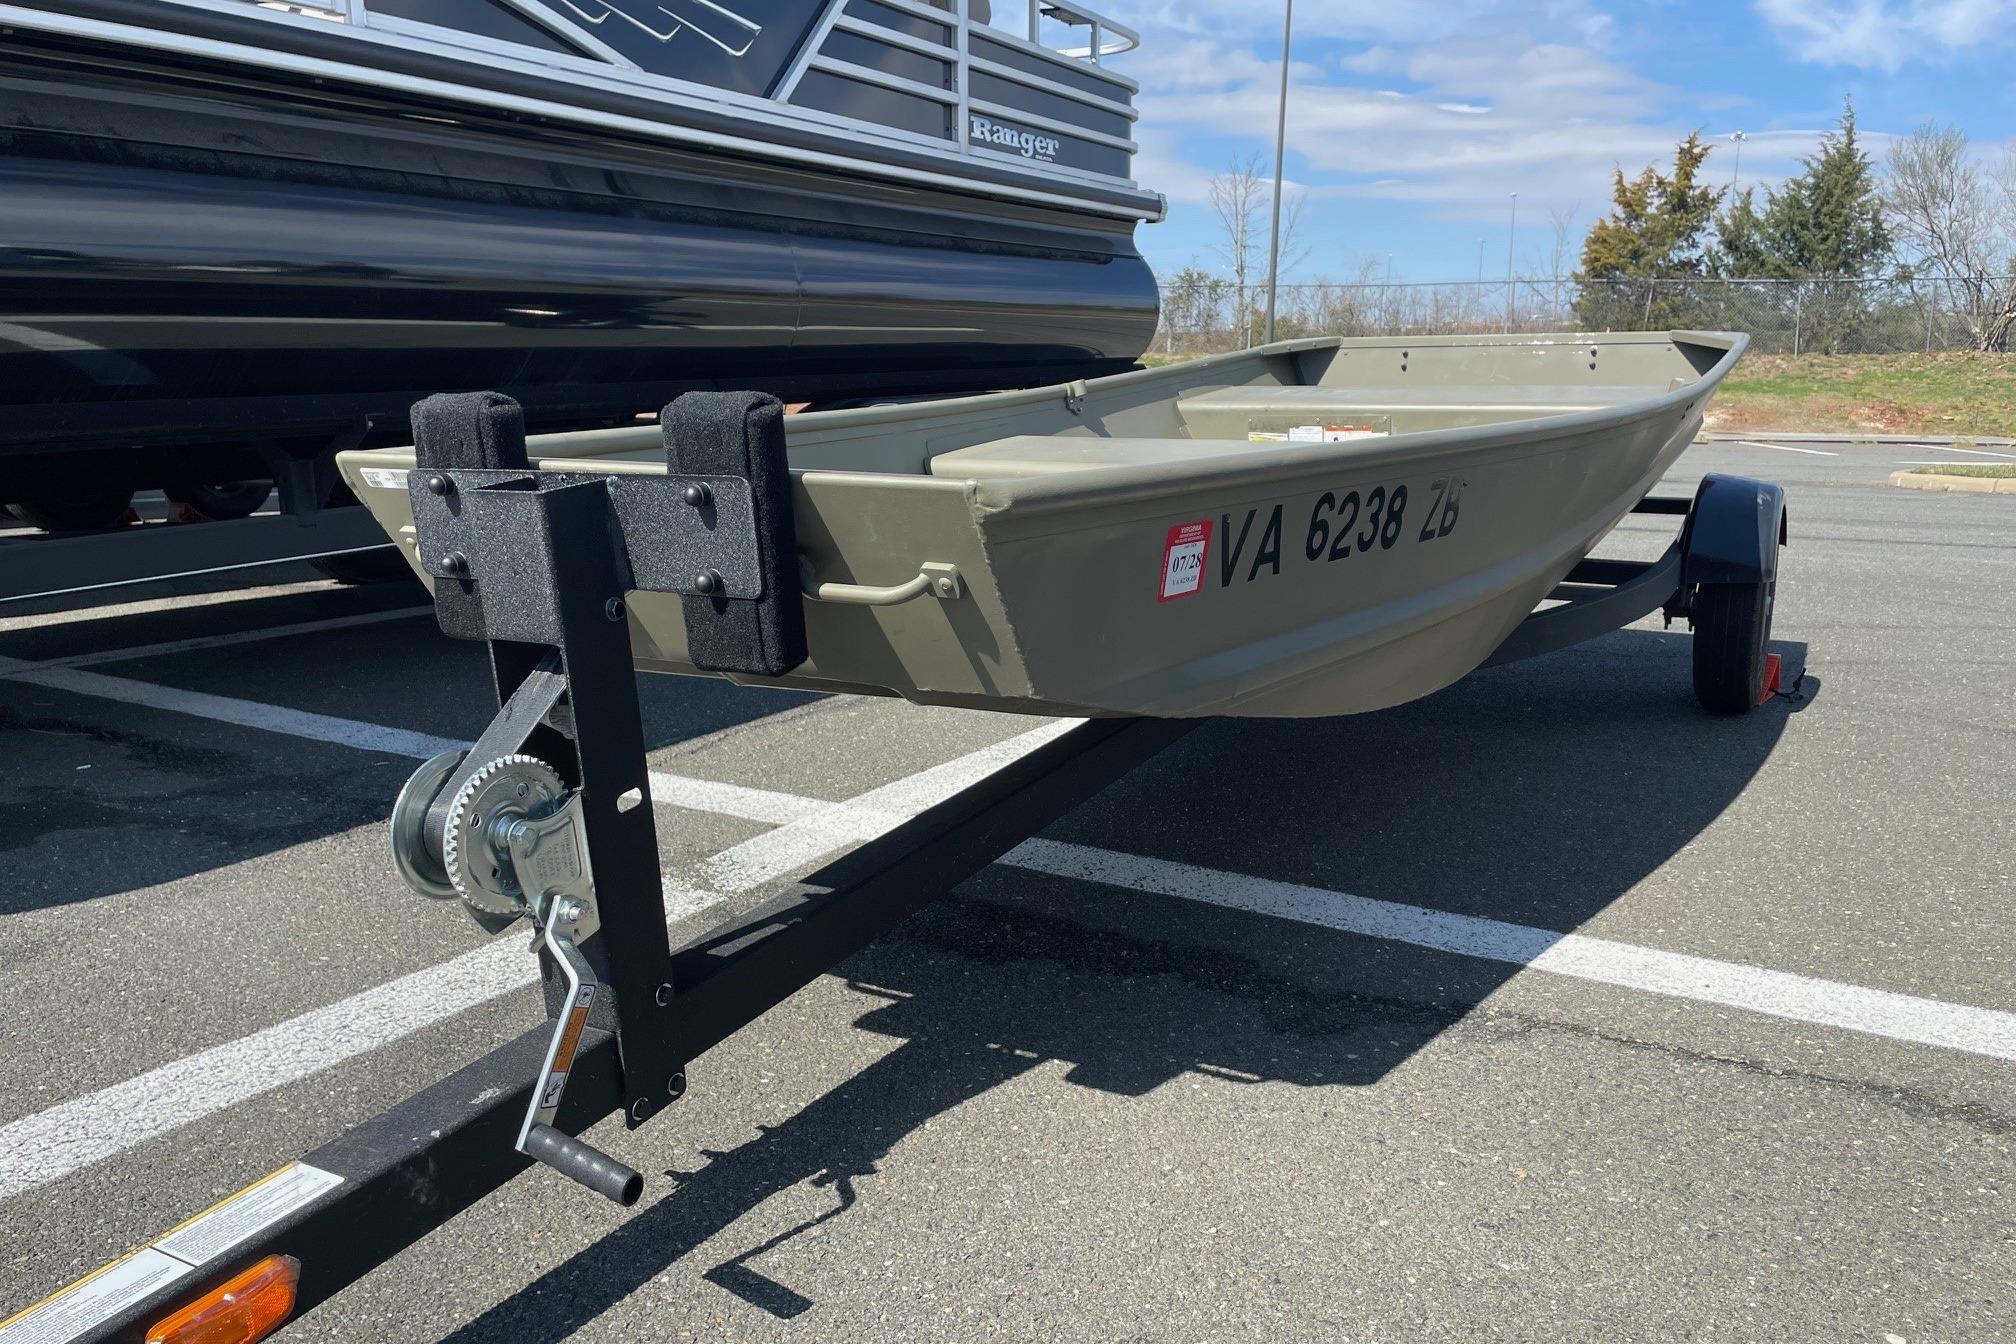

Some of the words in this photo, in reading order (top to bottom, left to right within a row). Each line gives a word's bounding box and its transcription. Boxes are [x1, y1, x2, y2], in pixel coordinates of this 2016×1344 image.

[970, 116, 1059, 157] Ranger
[1221, 504, 1283, 588] VA
[1306, 485, 1408, 563] 6238
[1418, 477, 1461, 543] ZB
[1172, 552, 1203, 573] 07/28
